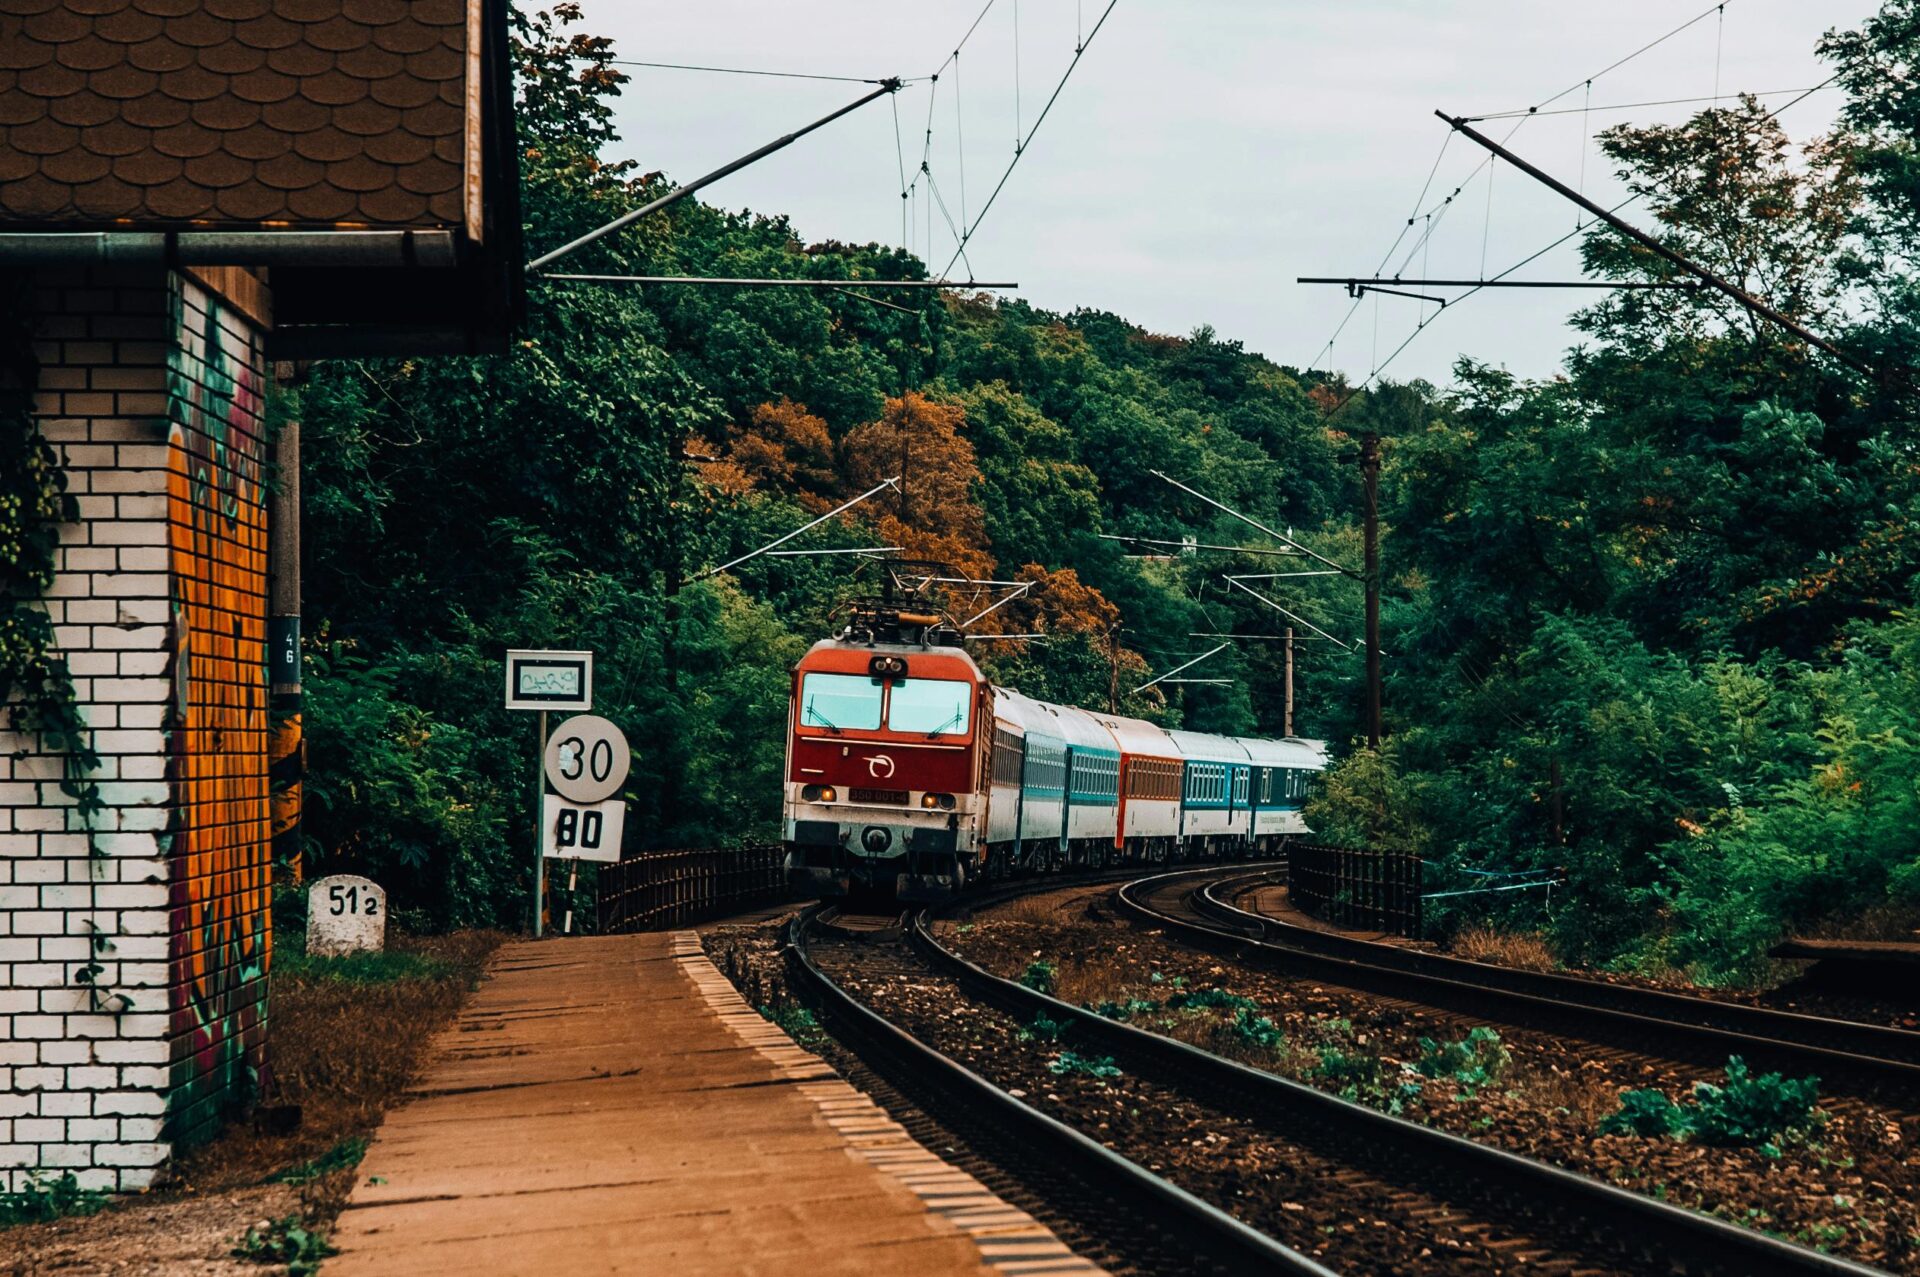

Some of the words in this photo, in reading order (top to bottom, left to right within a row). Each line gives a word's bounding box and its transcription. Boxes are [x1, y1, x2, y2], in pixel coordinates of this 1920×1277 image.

[286, 633, 293, 646] 4
[286, 650, 294, 664] 6
[558, 736, 613, 783] 30
[557, 808, 603, 849] 80
